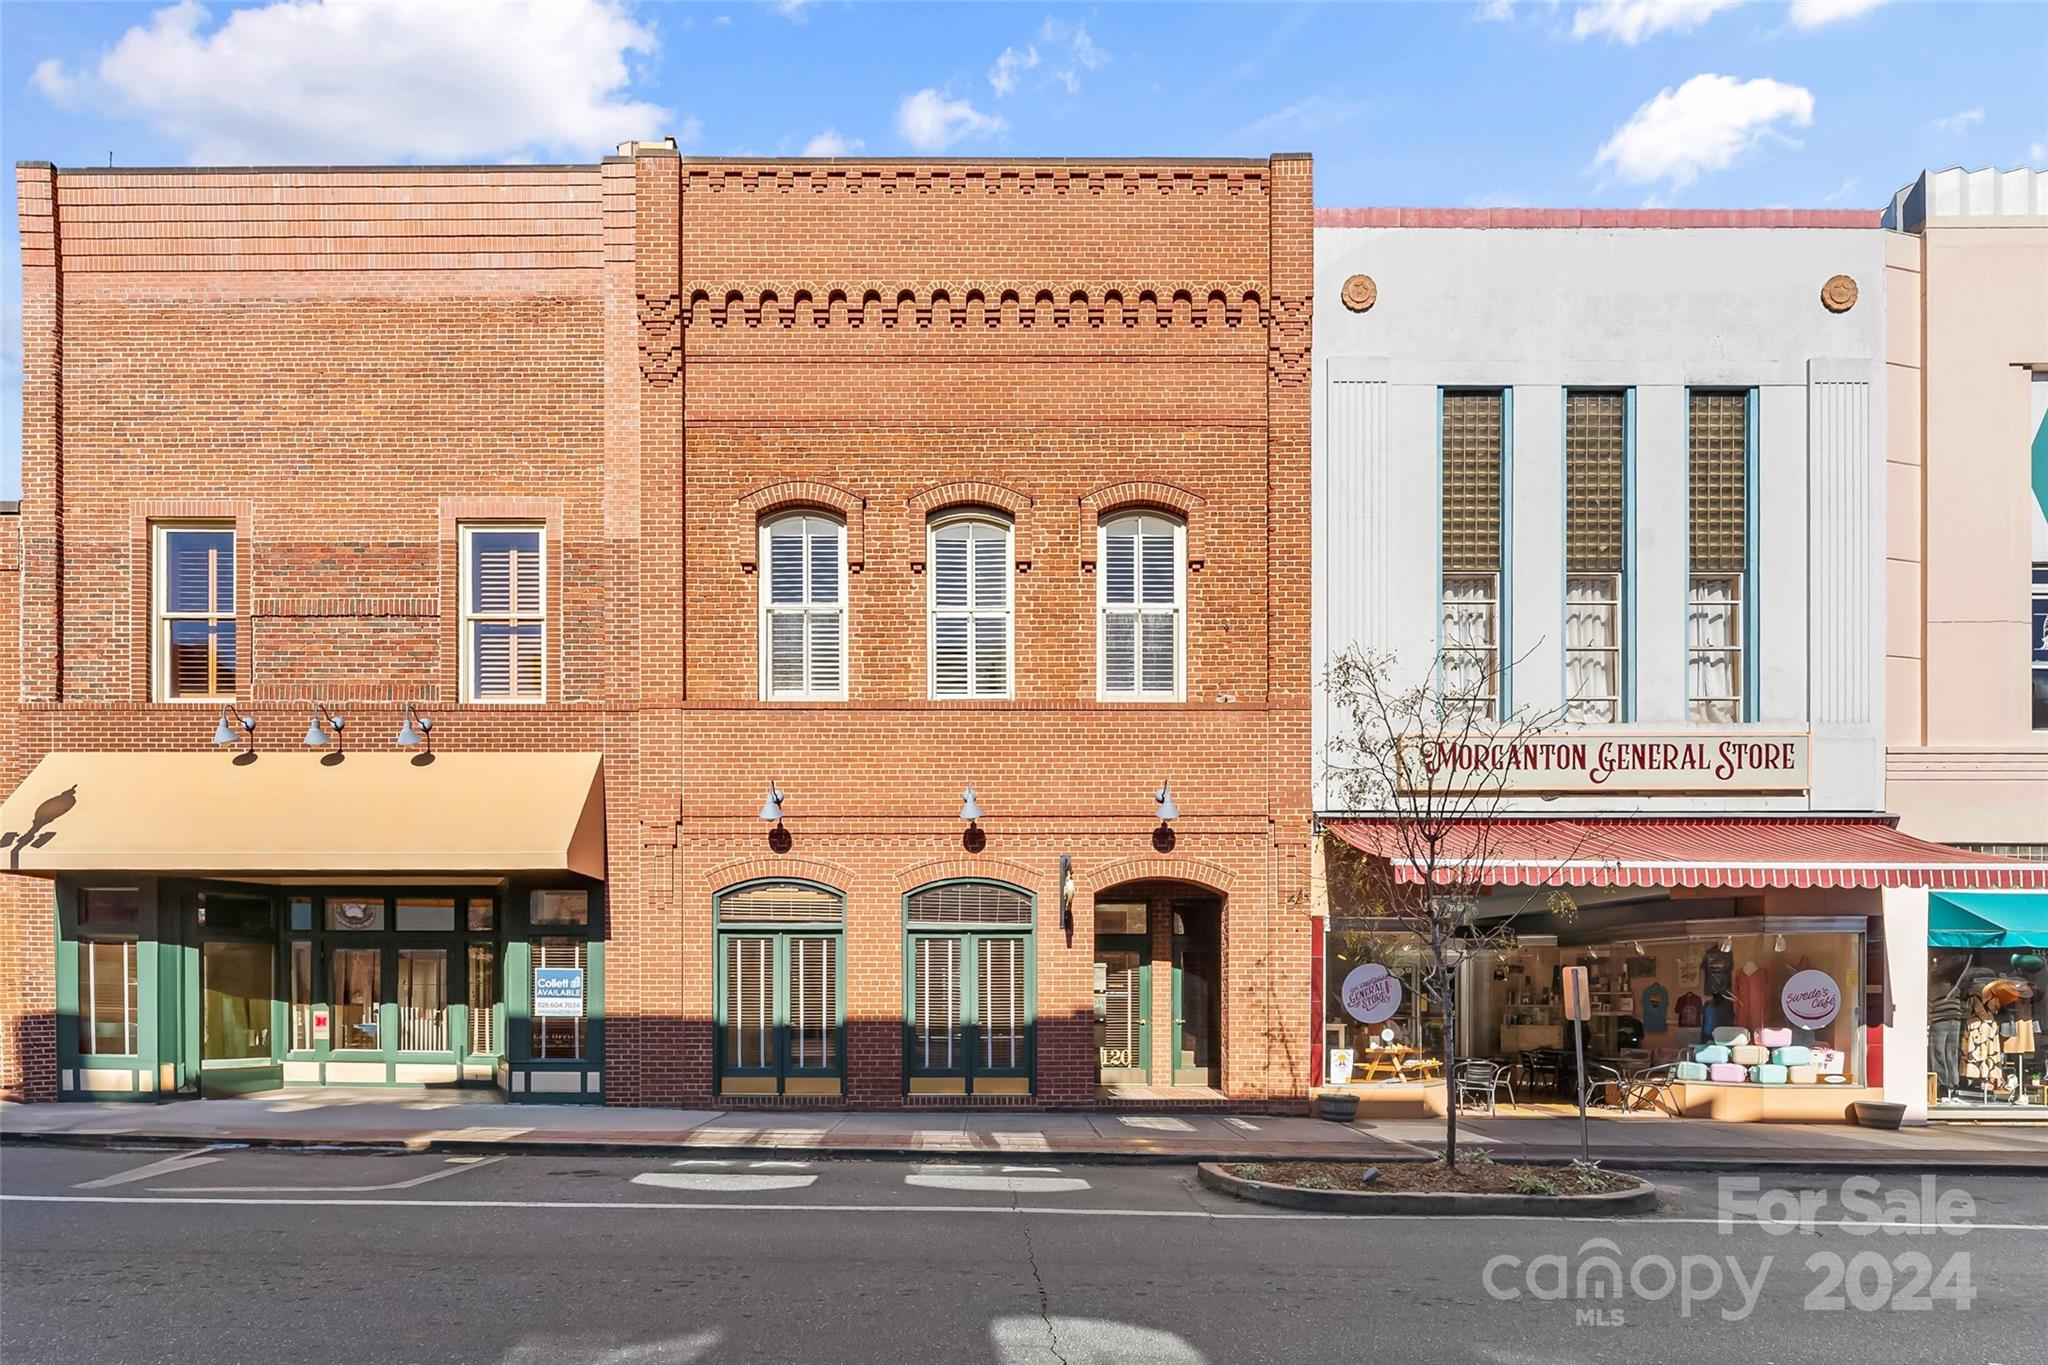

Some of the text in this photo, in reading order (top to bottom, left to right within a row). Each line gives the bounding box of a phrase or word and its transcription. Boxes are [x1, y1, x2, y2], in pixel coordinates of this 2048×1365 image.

[1420, 741, 1795, 784] MORGANTON GENERAL STORE
[537, 978, 569, 988] Collett
[537, 989, 581, 997] AVAILABLE
[1347, 982, 1384, 1008] GENERAL
[1786, 987, 1828, 1004] Swede's
[1102, 1050, 1131, 1065] 120
